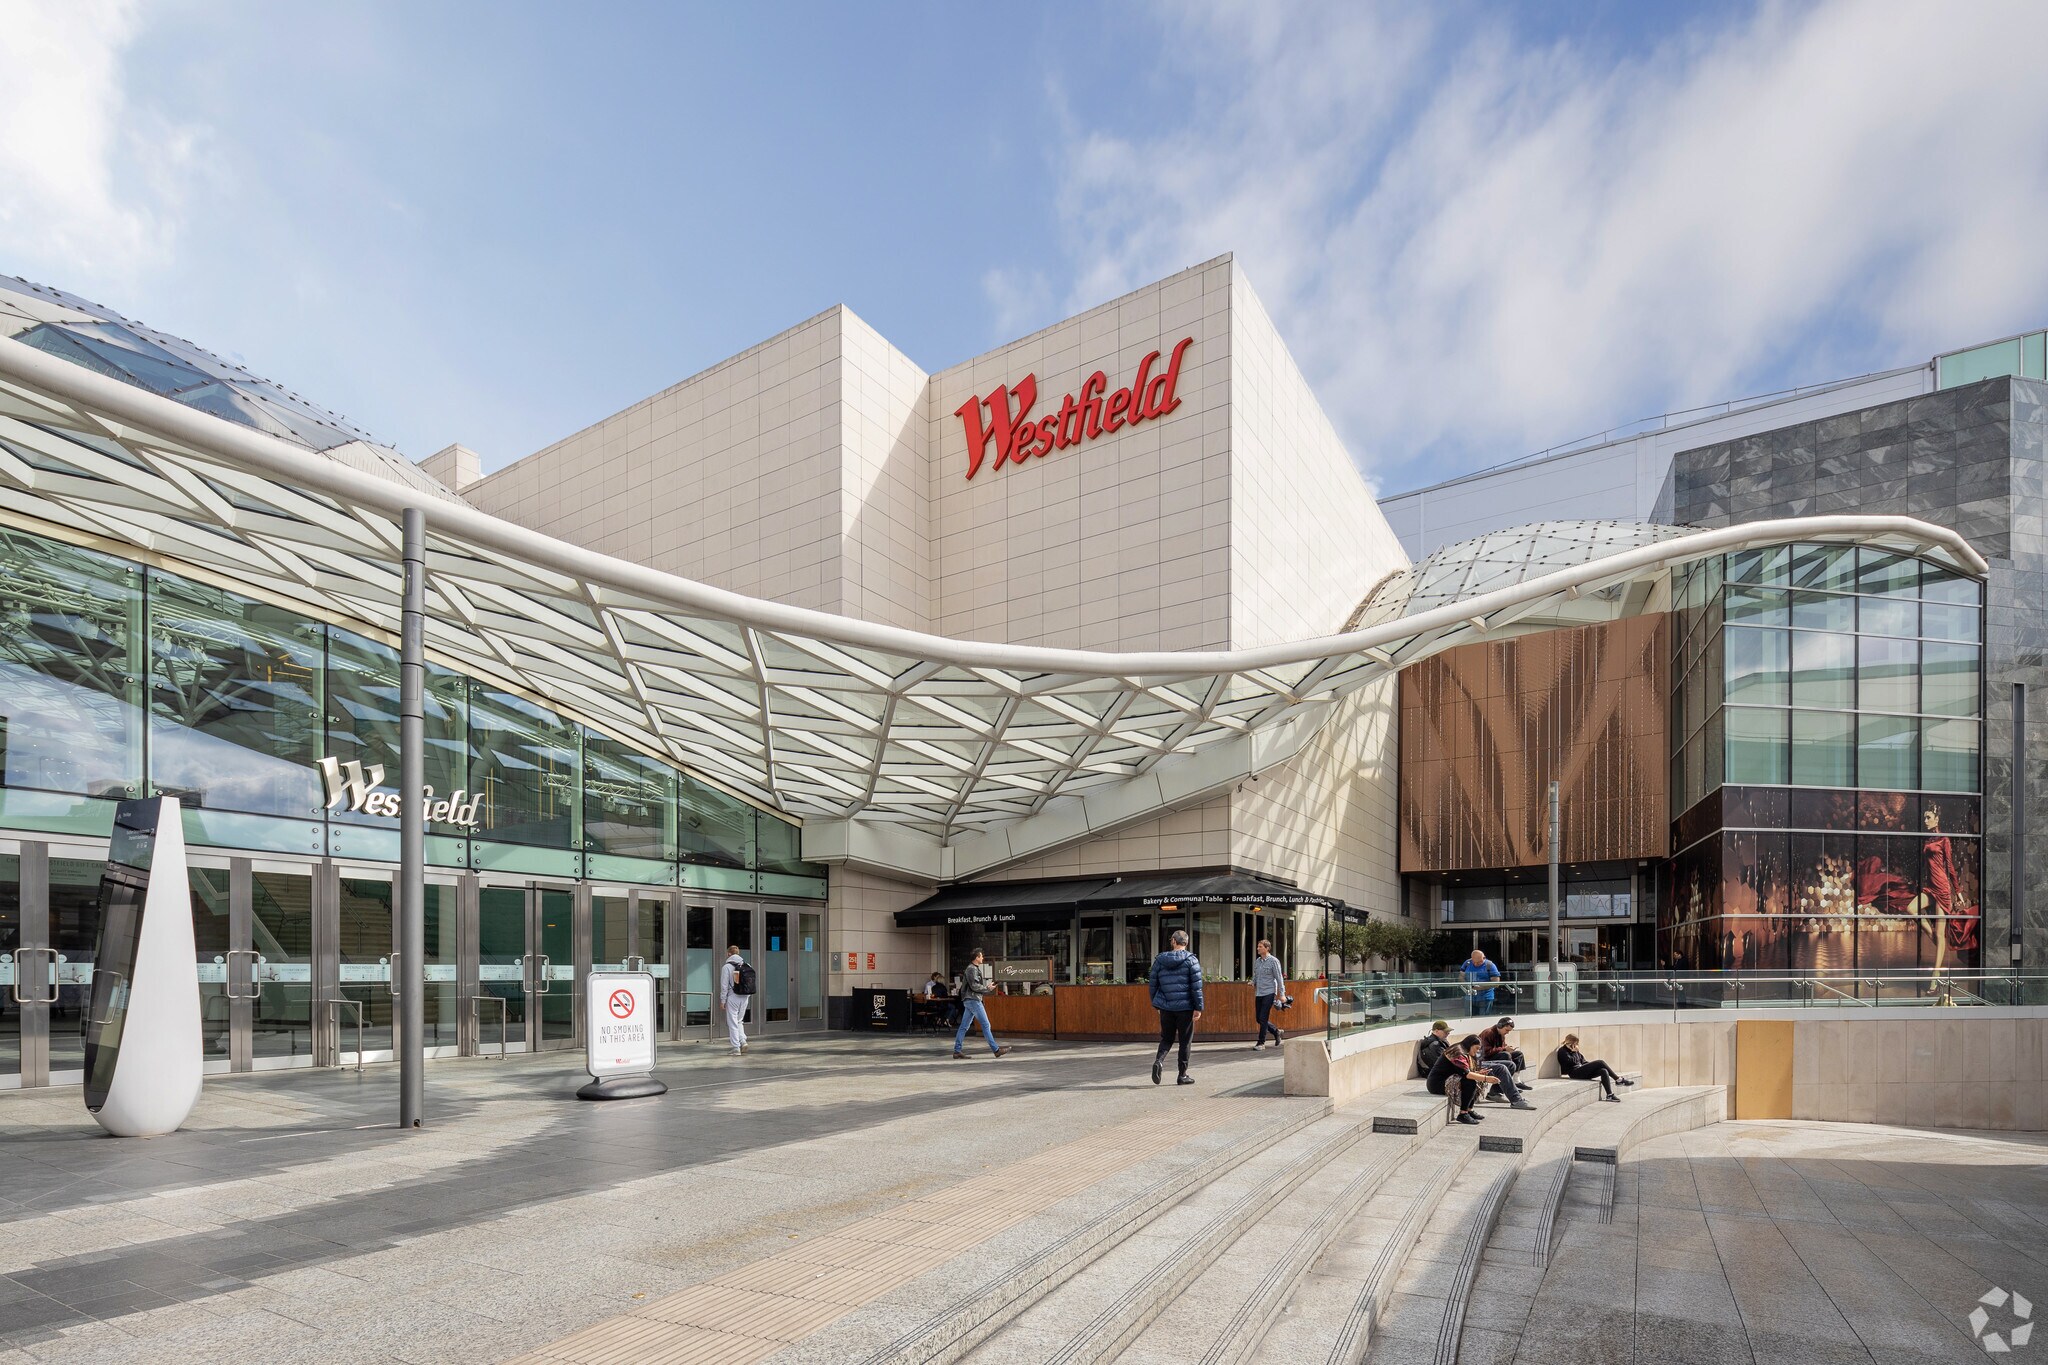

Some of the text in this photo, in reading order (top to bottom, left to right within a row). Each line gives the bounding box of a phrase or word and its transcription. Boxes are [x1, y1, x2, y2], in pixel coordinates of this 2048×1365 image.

[954, 336, 1193, 481] Westfield
[313, 756, 485, 827] Wesield
[1232, 895, 1264, 903] Breakfast,
[1265, 895, 1288, 903] Brunch,
[947, 916, 972, 924] Breakfast,
[993, 914, 998, 922] &
[601, 1024, 644, 1035] NO SMOKING
[599, 1033, 645, 1044] IN THIS AREA
